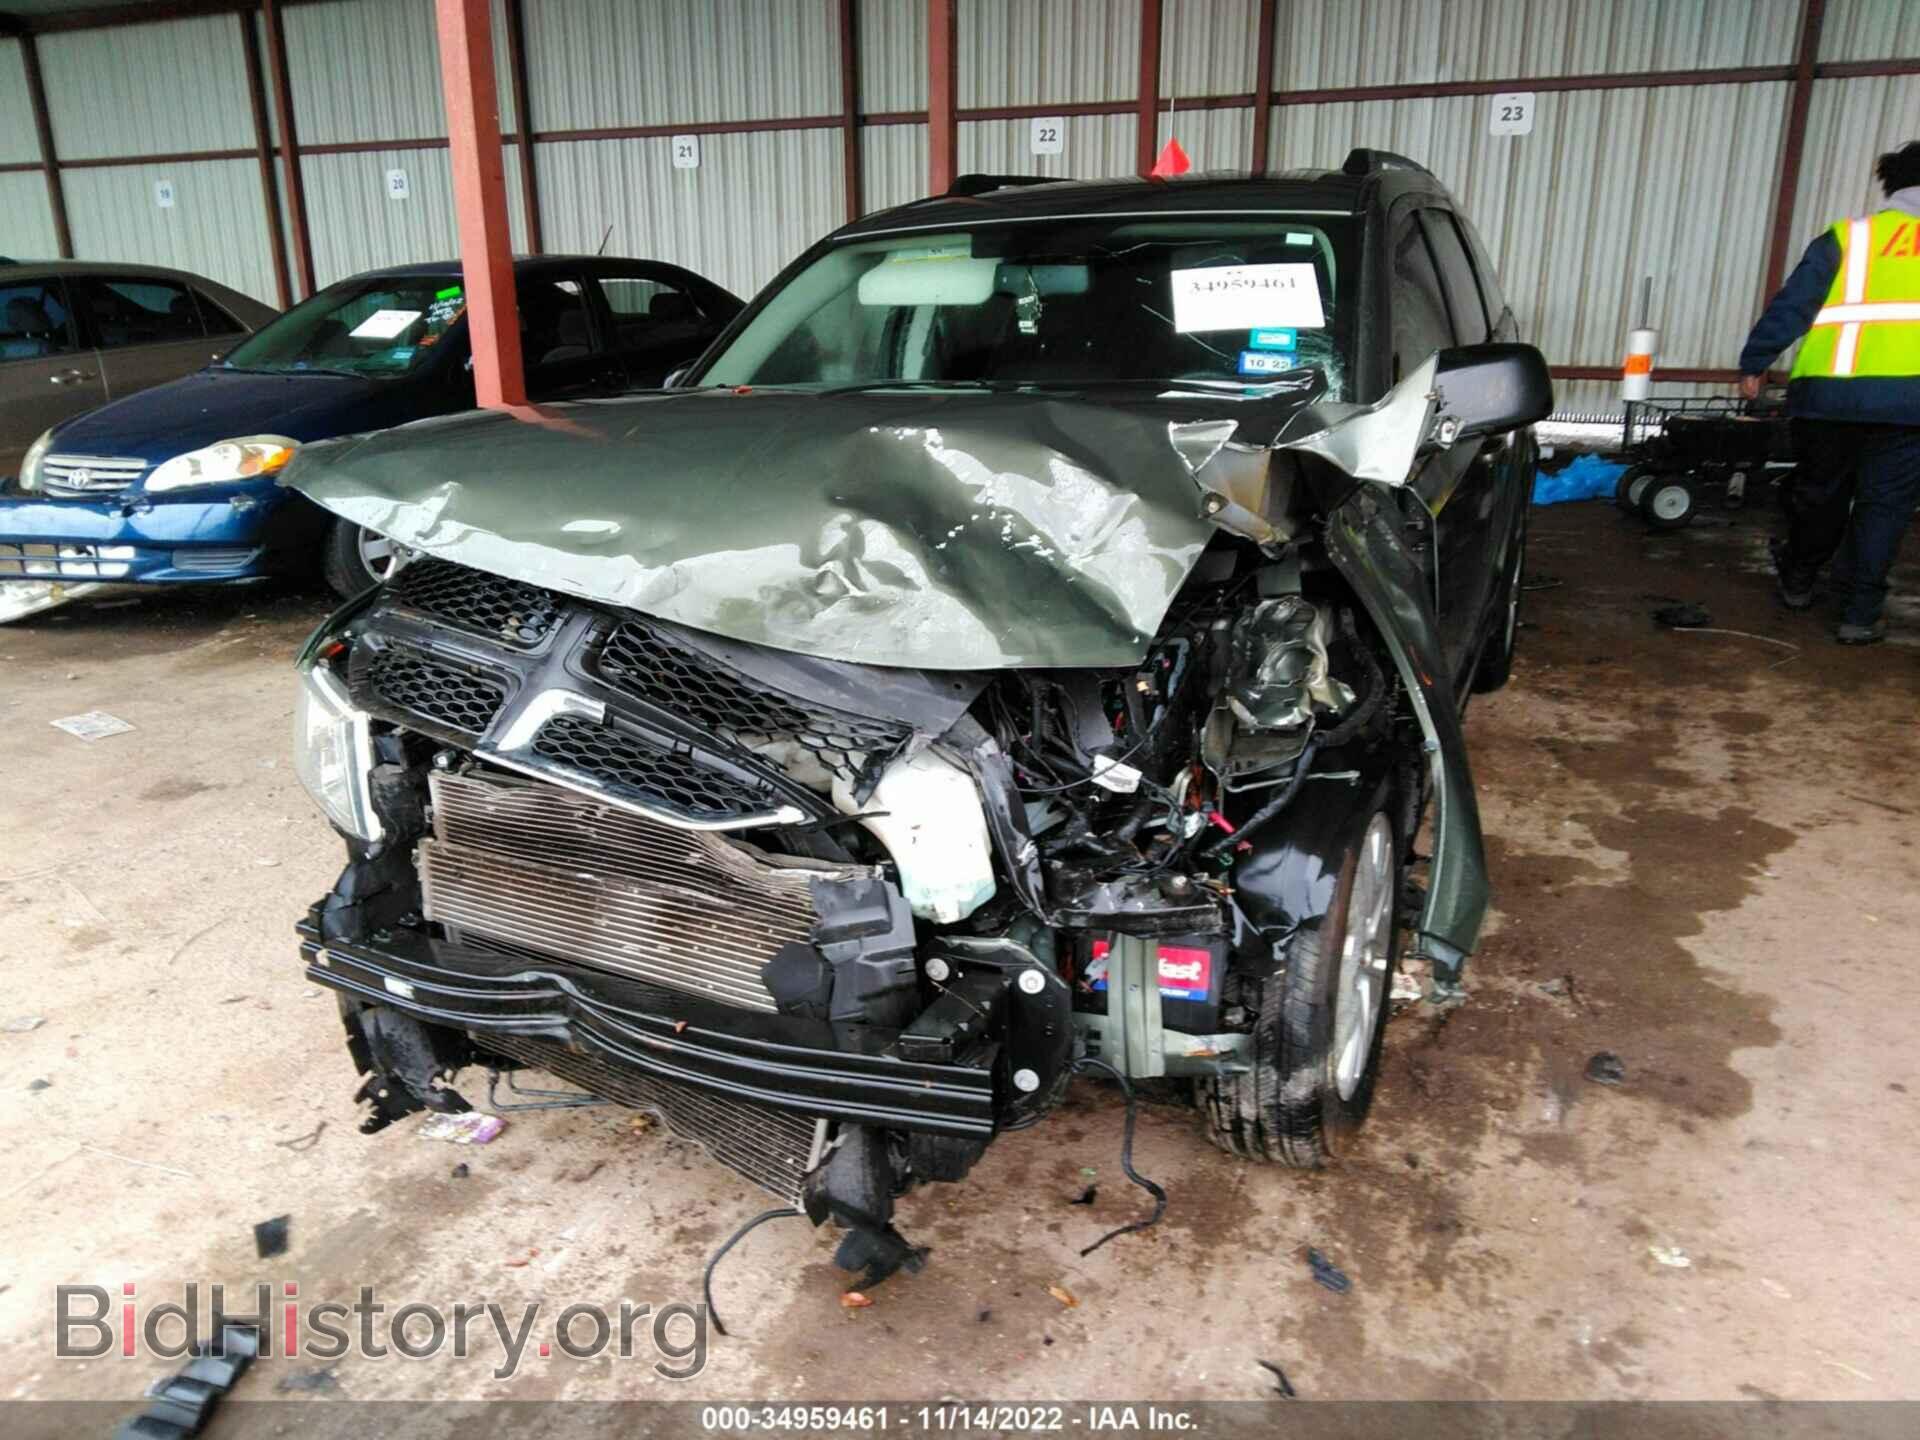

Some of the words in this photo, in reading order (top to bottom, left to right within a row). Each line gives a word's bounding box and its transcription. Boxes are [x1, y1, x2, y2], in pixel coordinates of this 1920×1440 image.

[1501, 106, 1524, 121] 23
[1039, 128, 1057, 142] 22
[679, 145, 692, 158] 21
[393, 179, 404, 190] 20
[1249, 358, 1265, 369] 10
